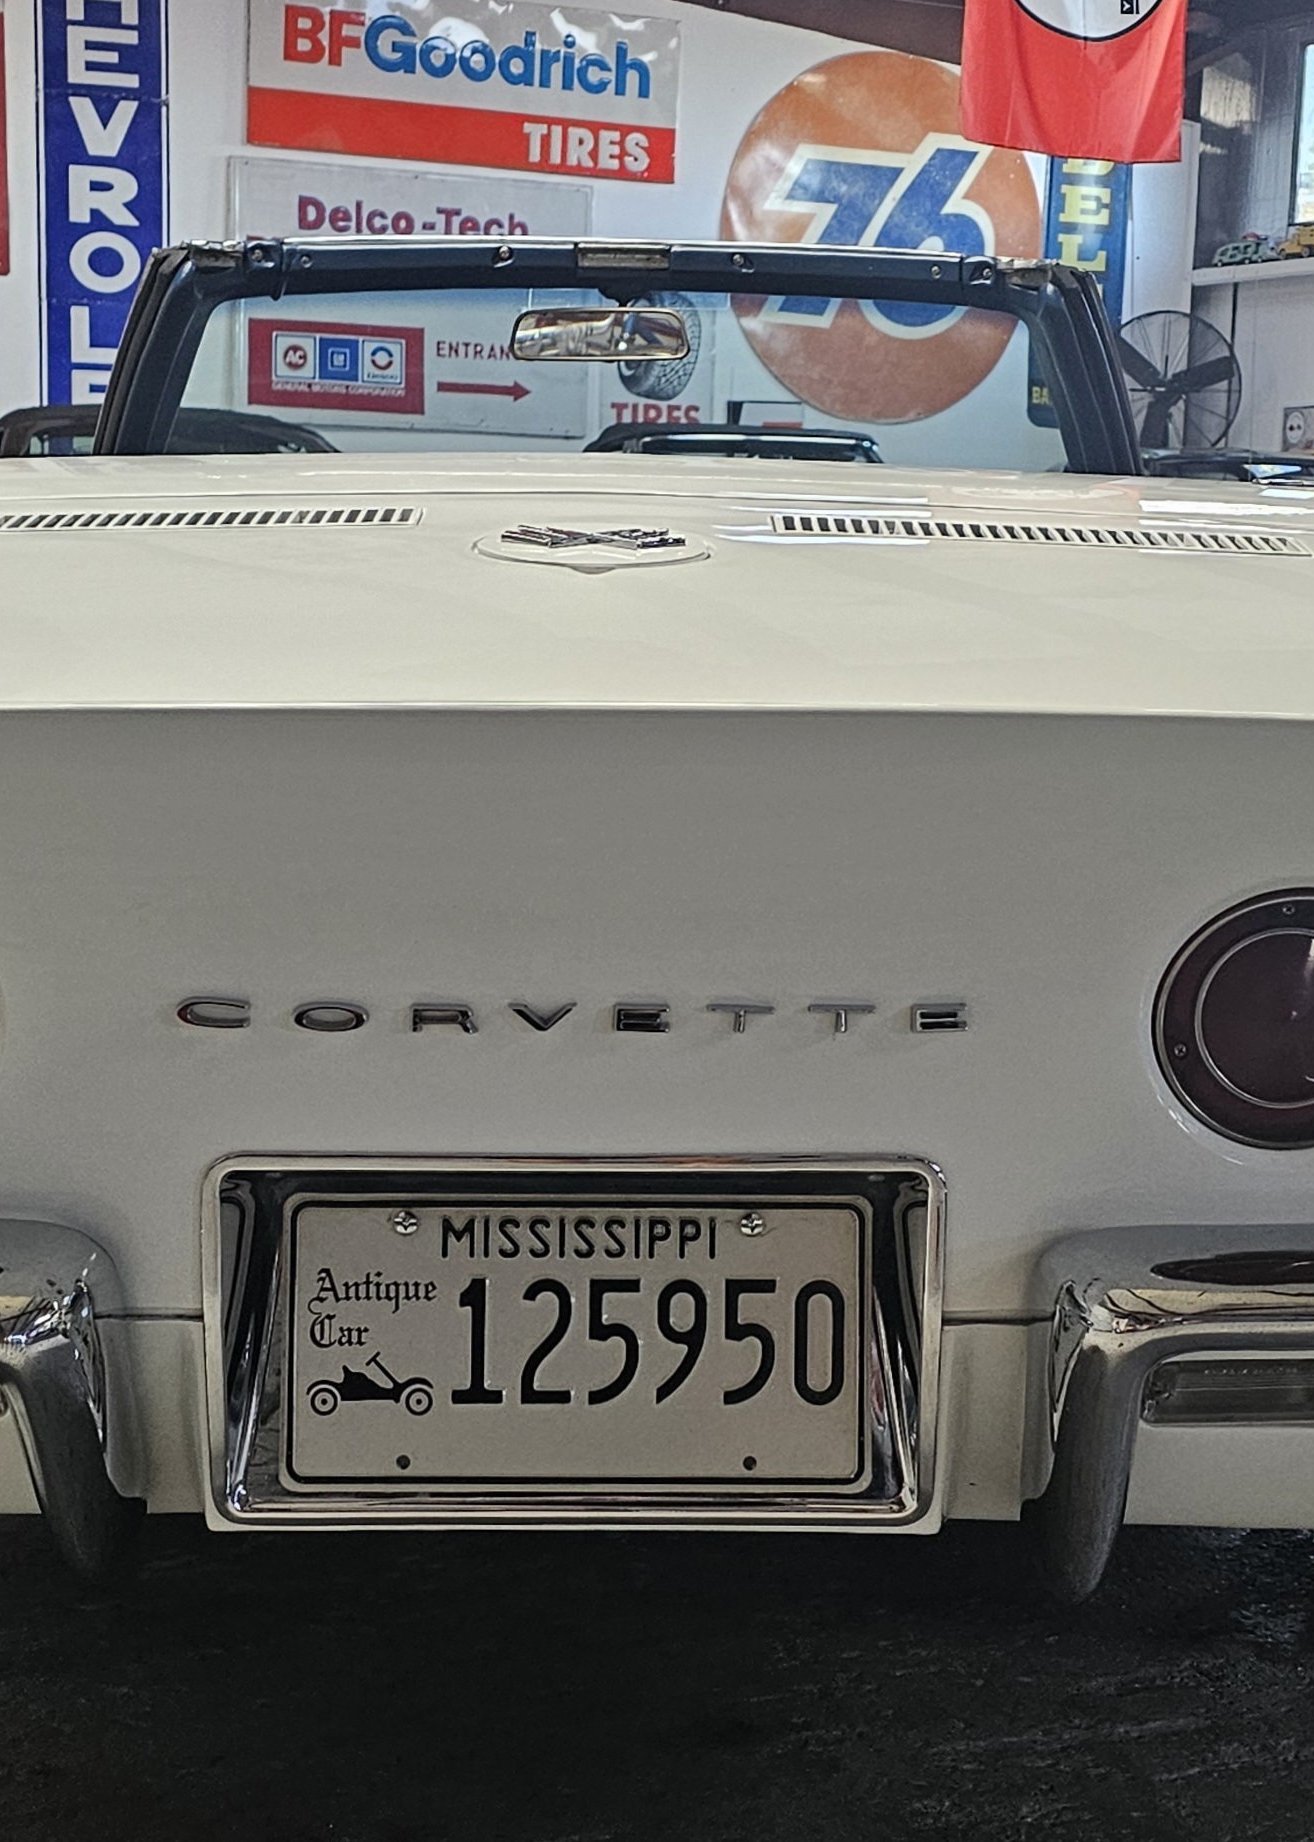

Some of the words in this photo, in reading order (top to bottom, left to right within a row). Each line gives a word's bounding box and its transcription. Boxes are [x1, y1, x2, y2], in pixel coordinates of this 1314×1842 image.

[283, 5, 651, 99] BFGoodrich
[523, 121, 651, 173] TIRES
[757, 132, 996, 341] 76
[175, 997, 971, 1035] CORVETTE
[440, 1215, 719, 1260] MISSISSIPPI
[307, 1266, 438, 1315] Antique
[307, 1312, 370, 1350] Car
[450, 1276, 847, 1407] 125950
